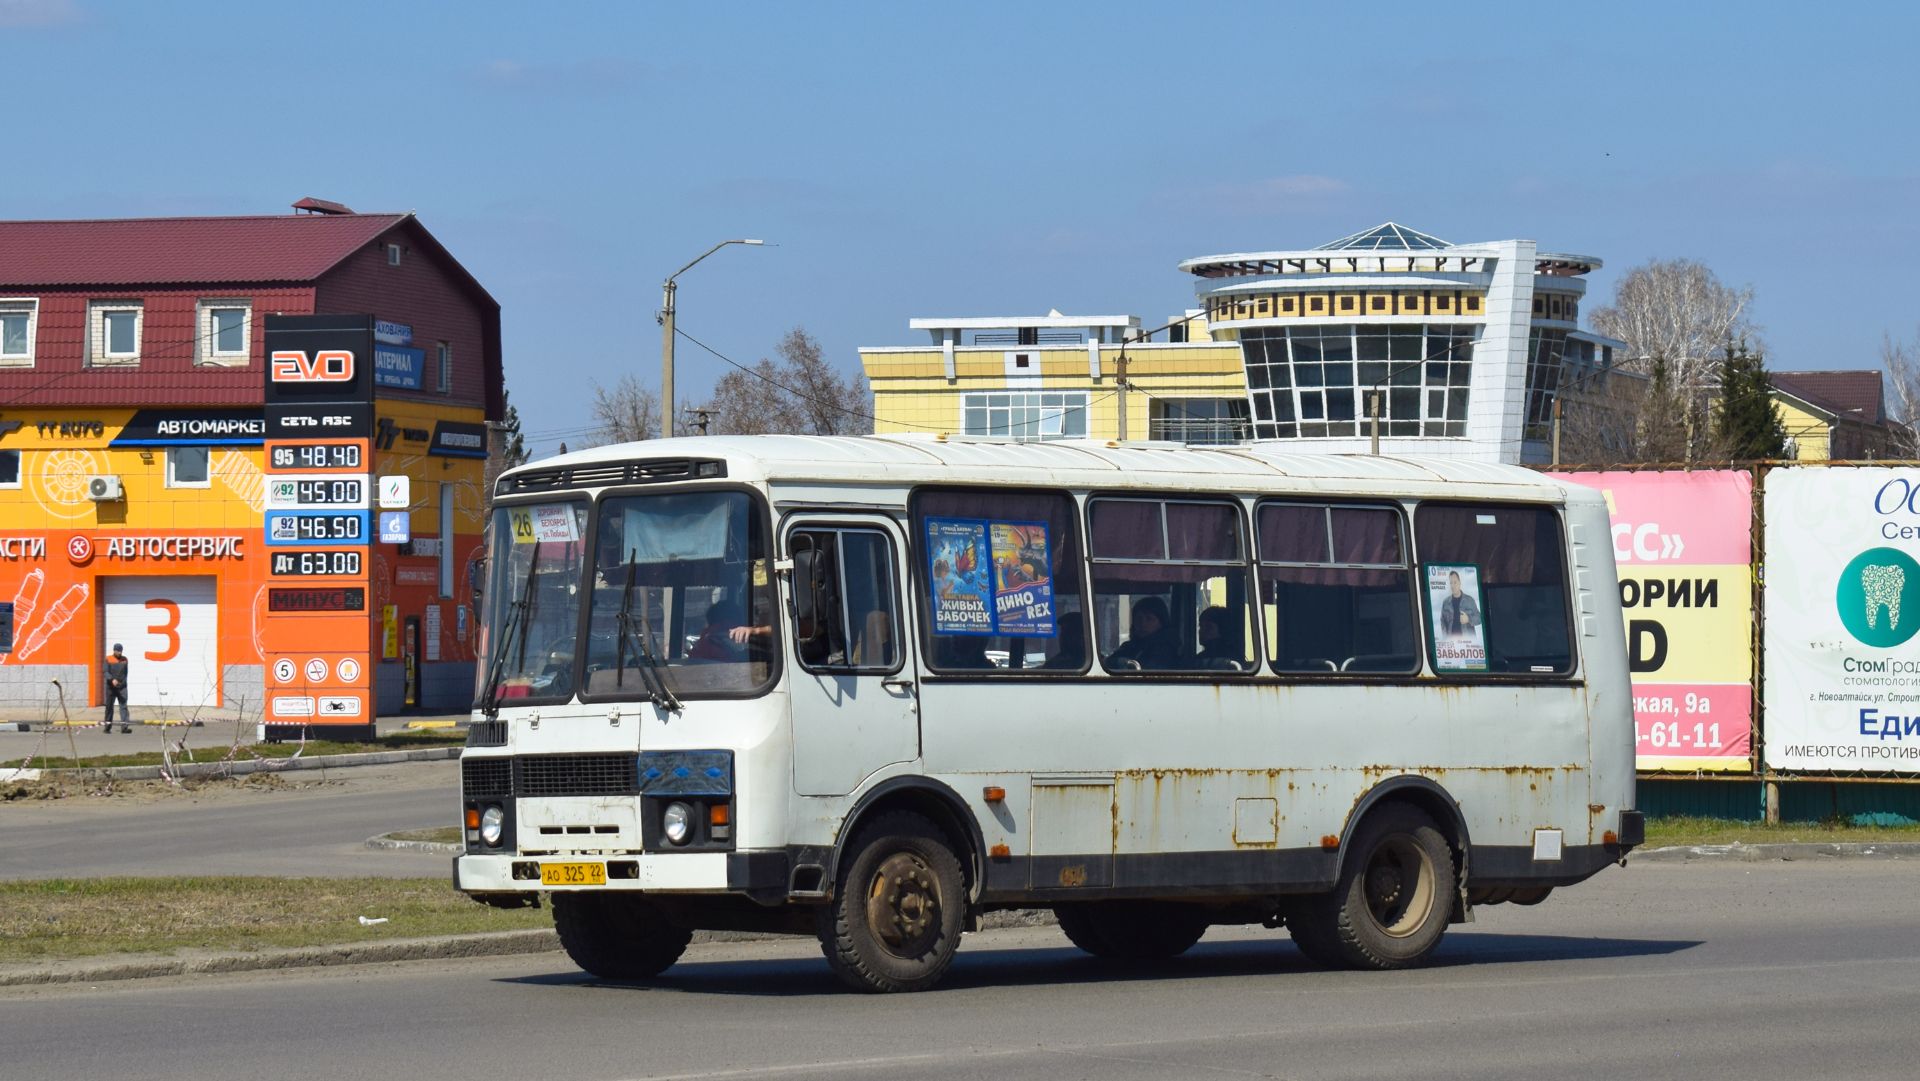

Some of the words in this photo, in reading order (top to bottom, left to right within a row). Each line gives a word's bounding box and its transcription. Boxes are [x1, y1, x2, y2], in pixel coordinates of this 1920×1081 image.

[271, 350, 355, 382] EVO
[157, 420, 266, 435] АВТОМАРКЕТ
[281, 416, 318, 426] СЕТЬ
[322, 416, 352, 426] АЗС
[274, 449, 294, 465] 95
[300, 445, 359, 467] 48.40
[280, 483, 295, 496] 92
[300, 481, 359, 502] 45.00
[280, 517, 295, 530] 92
[300, 517, 359, 538] 46.50
[513, 511, 532, 537] 26
[107, 536, 244, 558] АВТОСЕРВИС
[301, 553, 359, 574] 63.00
[273, 592, 343, 609] МИНУС
[996, 591, 1034, 613] ДИНО
[1618, 578, 1718, 608] ОРИИ
[941, 599, 985, 611] ЖИВЫХ
[1026, 602, 1051, 619] REX
[936, 610, 991, 623] БАБОЧЕК
[144, 598, 182, 662] 3
[1436, 649, 1485, 659] ЗАВЬЯЛОВ
[279, 664, 290, 678] 5
[1684, 692, 1711, 714] 9а
[1859, 708, 1920, 741] Еди
[1784, 745, 1857, 758] ИМЕЮТСЯ
[563, 865, 585, 882] 325
[590, 864, 601, 877] 22
